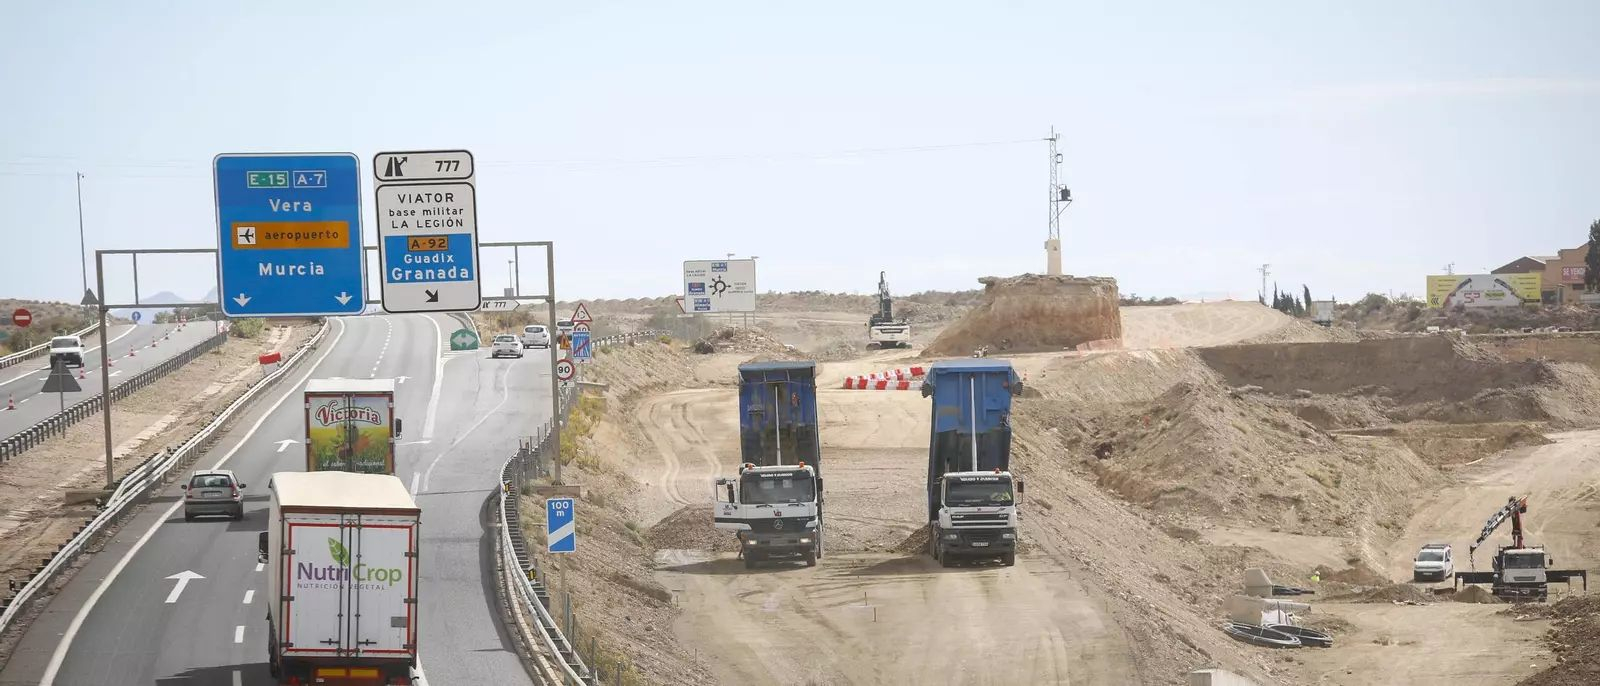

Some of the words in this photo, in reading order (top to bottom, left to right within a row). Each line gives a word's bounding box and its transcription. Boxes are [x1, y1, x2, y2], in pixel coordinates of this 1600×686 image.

[435, 160, 460, 172] 777
[249, 173, 286, 185] E-15
[296, 173, 323, 185] A-7
[397, 193, 454, 204] VIATOR
[269, 198, 312, 213] Vera
[389, 208, 416, 217] base
[422, 207, 464, 216] militar
[391, 219, 409, 229] LA
[416, 216, 464, 228] LEGIÓN
[264, 230, 339, 244] aeropuerto
[411, 238, 447, 250] A-92
[404, 253, 454, 264] Guadix
[259, 261, 325, 276] Murcia
[391, 266, 469, 281] Granada
[316, 400, 381, 425] Victoria
[551, 501, 569, 509] 100
